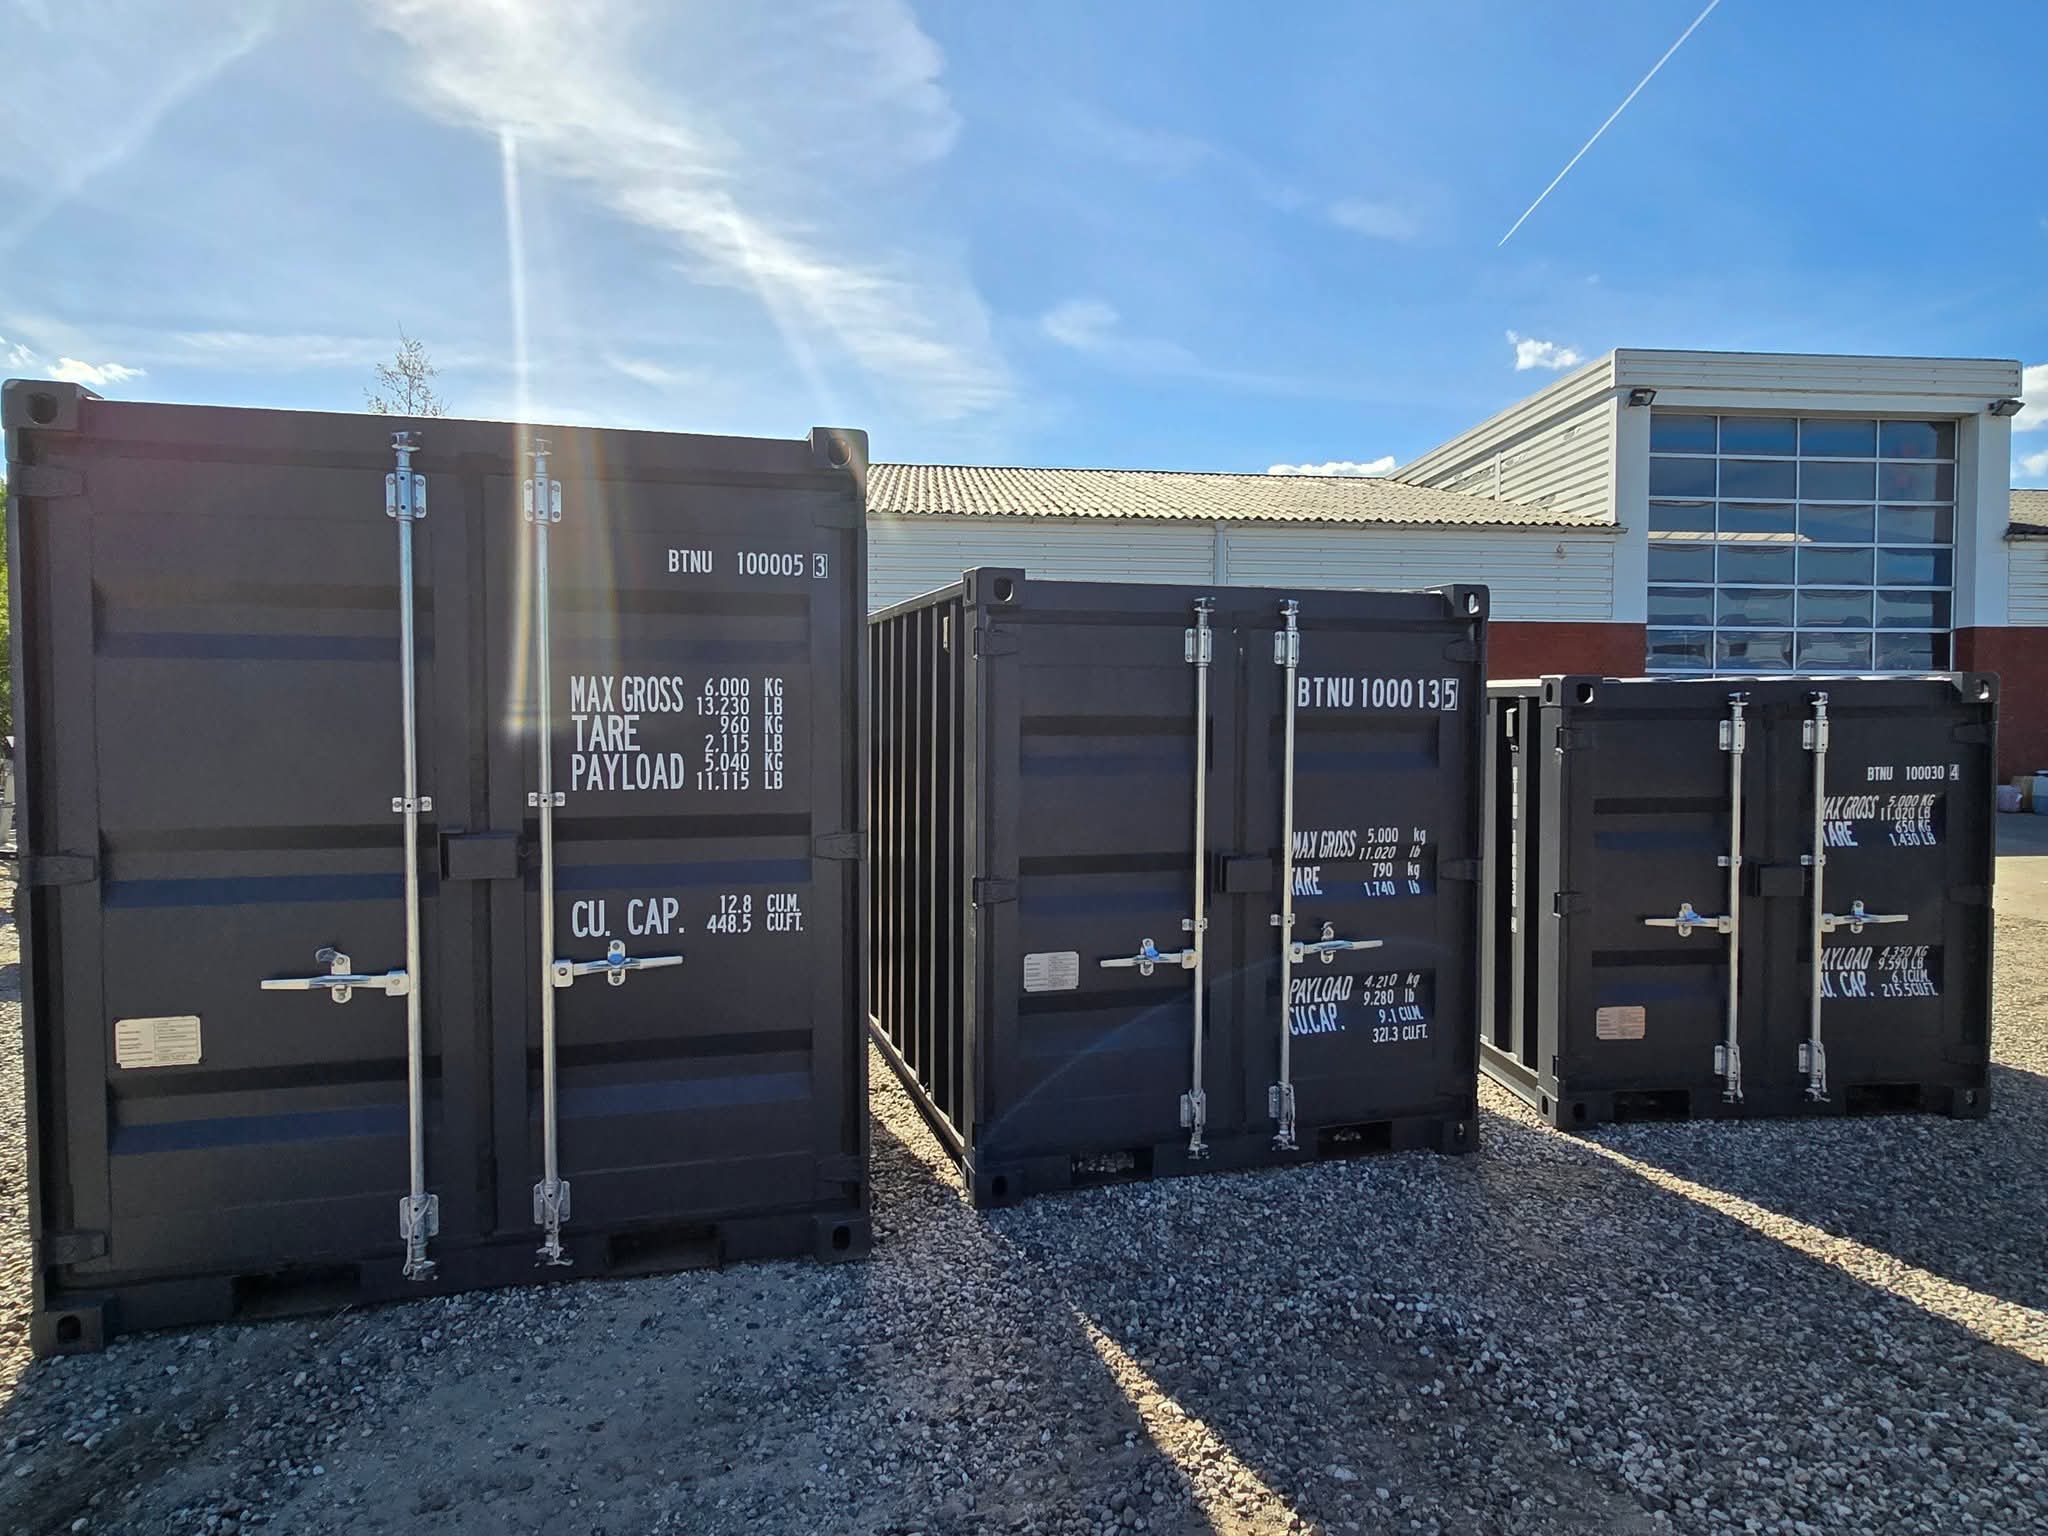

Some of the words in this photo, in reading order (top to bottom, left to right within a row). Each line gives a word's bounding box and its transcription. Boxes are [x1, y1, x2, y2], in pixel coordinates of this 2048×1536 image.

[668, 549, 713, 573] BTNU
[737, 552, 804, 577] 100005
[570, 676, 615, 712] MAX
[621, 676, 684, 712] GROSS
[764, 678, 783, 697] KG
[1297, 677, 1354, 707] BTNU
[1360, 678, 1440, 708] 100013
[764, 697, 783, 715] LB
[571, 715, 641, 752] TARE
[720, 716, 750, 734] 960
[764, 716, 783, 734] KG
[764, 734, 783, 753] LB
[764, 753, 783, 772] KG
[571, 753, 685, 791] PAYLOAD
[764, 772, 783, 790] LB
[1867, 766, 1893, 781] BTNU
[1905, 765, 1945, 780] 100030
[1843, 795, 1880, 819] GROSS
[1887, 794, 1919, 807] 5.000
[1920, 794, 1936, 806] KG
[1880, 807, 1915, 821] 11.020
[1918, 806, 1931, 819] LB
[1895, 820, 1915, 833] 650
[1918, 819, 1931, 832] KG
[1291, 831, 1318, 859] MAX
[1319, 830, 1357, 858] GROSS
[1367, 827, 1399, 844] 5.000
[1413, 827, 1426, 845] kg
[1889, 833, 1920, 846] 1.430
[1920, 832, 1937, 845] LB
[1359, 846, 1397, 860] 11.020
[1409, 845, 1421, 858] lb
[1372, 862, 1393, 878] 790
[1407, 861, 1420, 880] kg
[1364, 880, 1396, 896] 1.740
[1408, 880, 1420, 894] lb
[720, 895, 752, 914] 12.8
[571, 899, 611, 937] CU.
[627, 898, 685, 936] CAP.
[707, 914, 752, 933] 448.5
[1820, 947, 1873, 970] AYLOAD
[1915, 945, 1929, 957] KG
[1911, 957, 1924, 969] LB
[1289, 975, 1353, 1004] PAYLOAD
[1364, 973, 1398, 989] 4.210
[1406, 972, 1420, 988] kg
[1363, 989, 1394, 1006] 9.280
[1378, 1008, 1398, 1023] 9.1
[1372, 1026, 1398, 1043] 321.3
